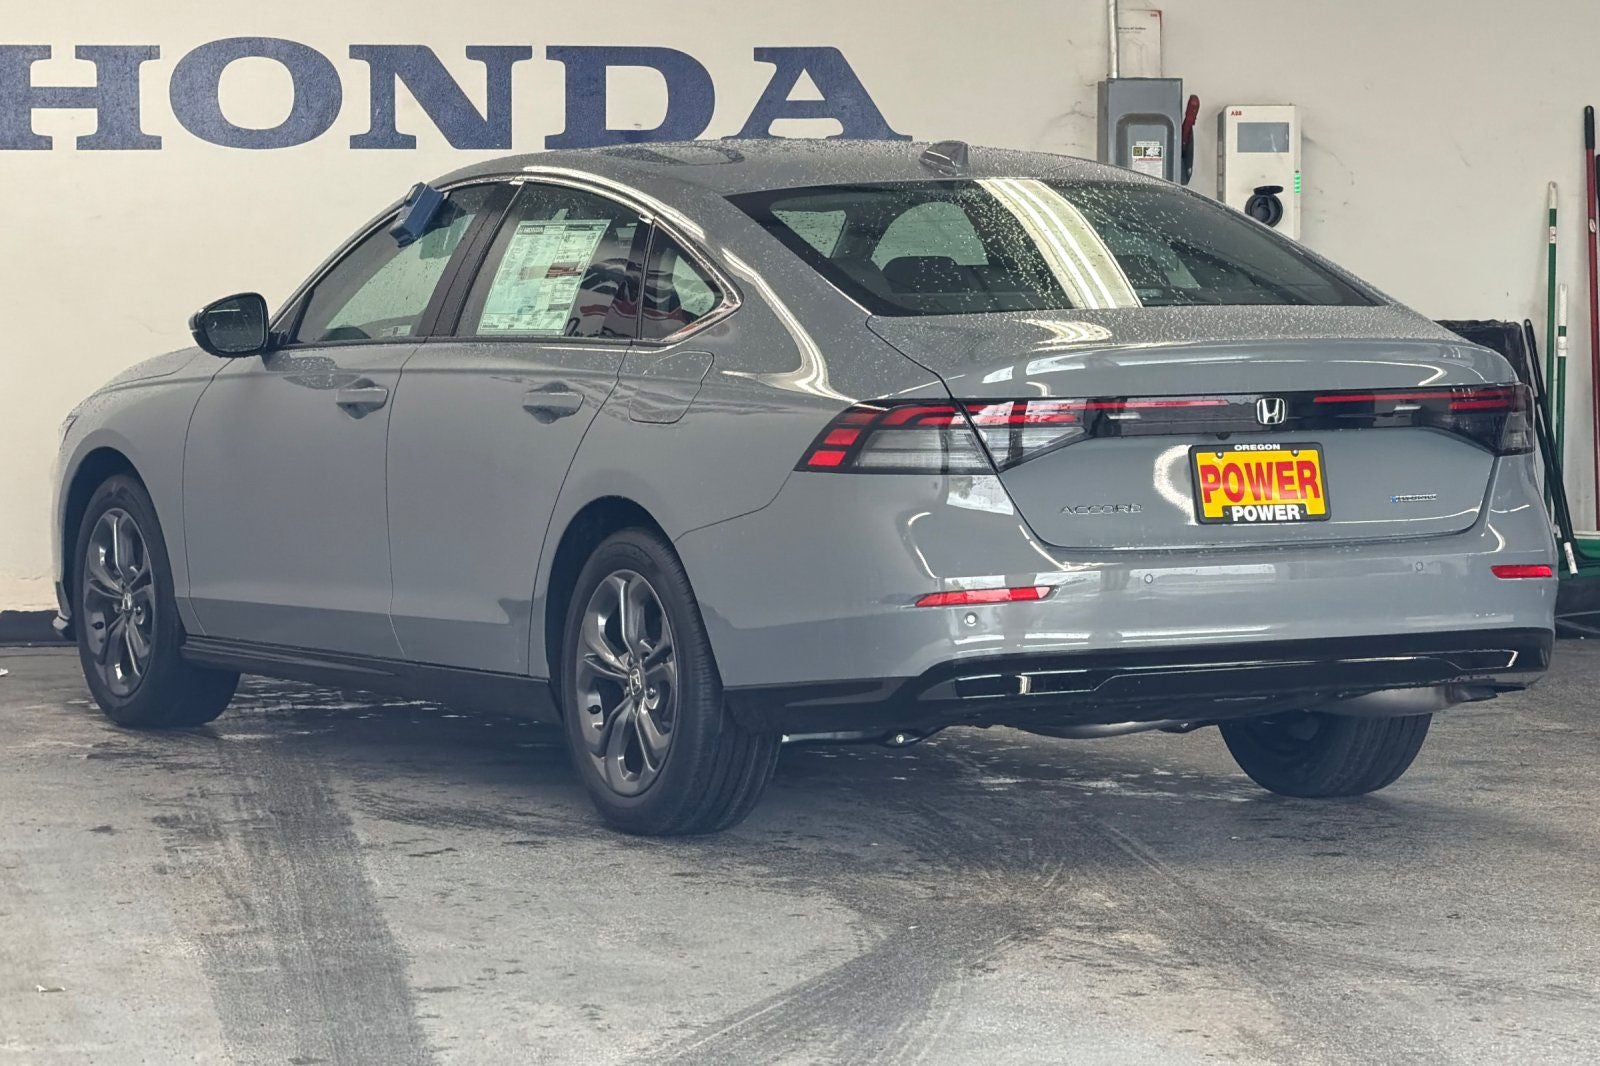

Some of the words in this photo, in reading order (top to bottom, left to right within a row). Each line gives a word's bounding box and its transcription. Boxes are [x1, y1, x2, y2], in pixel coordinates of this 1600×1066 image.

[0, 36, 912, 151] HONDA
[1200, 460, 1320, 503] POWER
[1059, 503, 1142, 515] ACCORD
[1231, 504, 1301, 521] POWER
